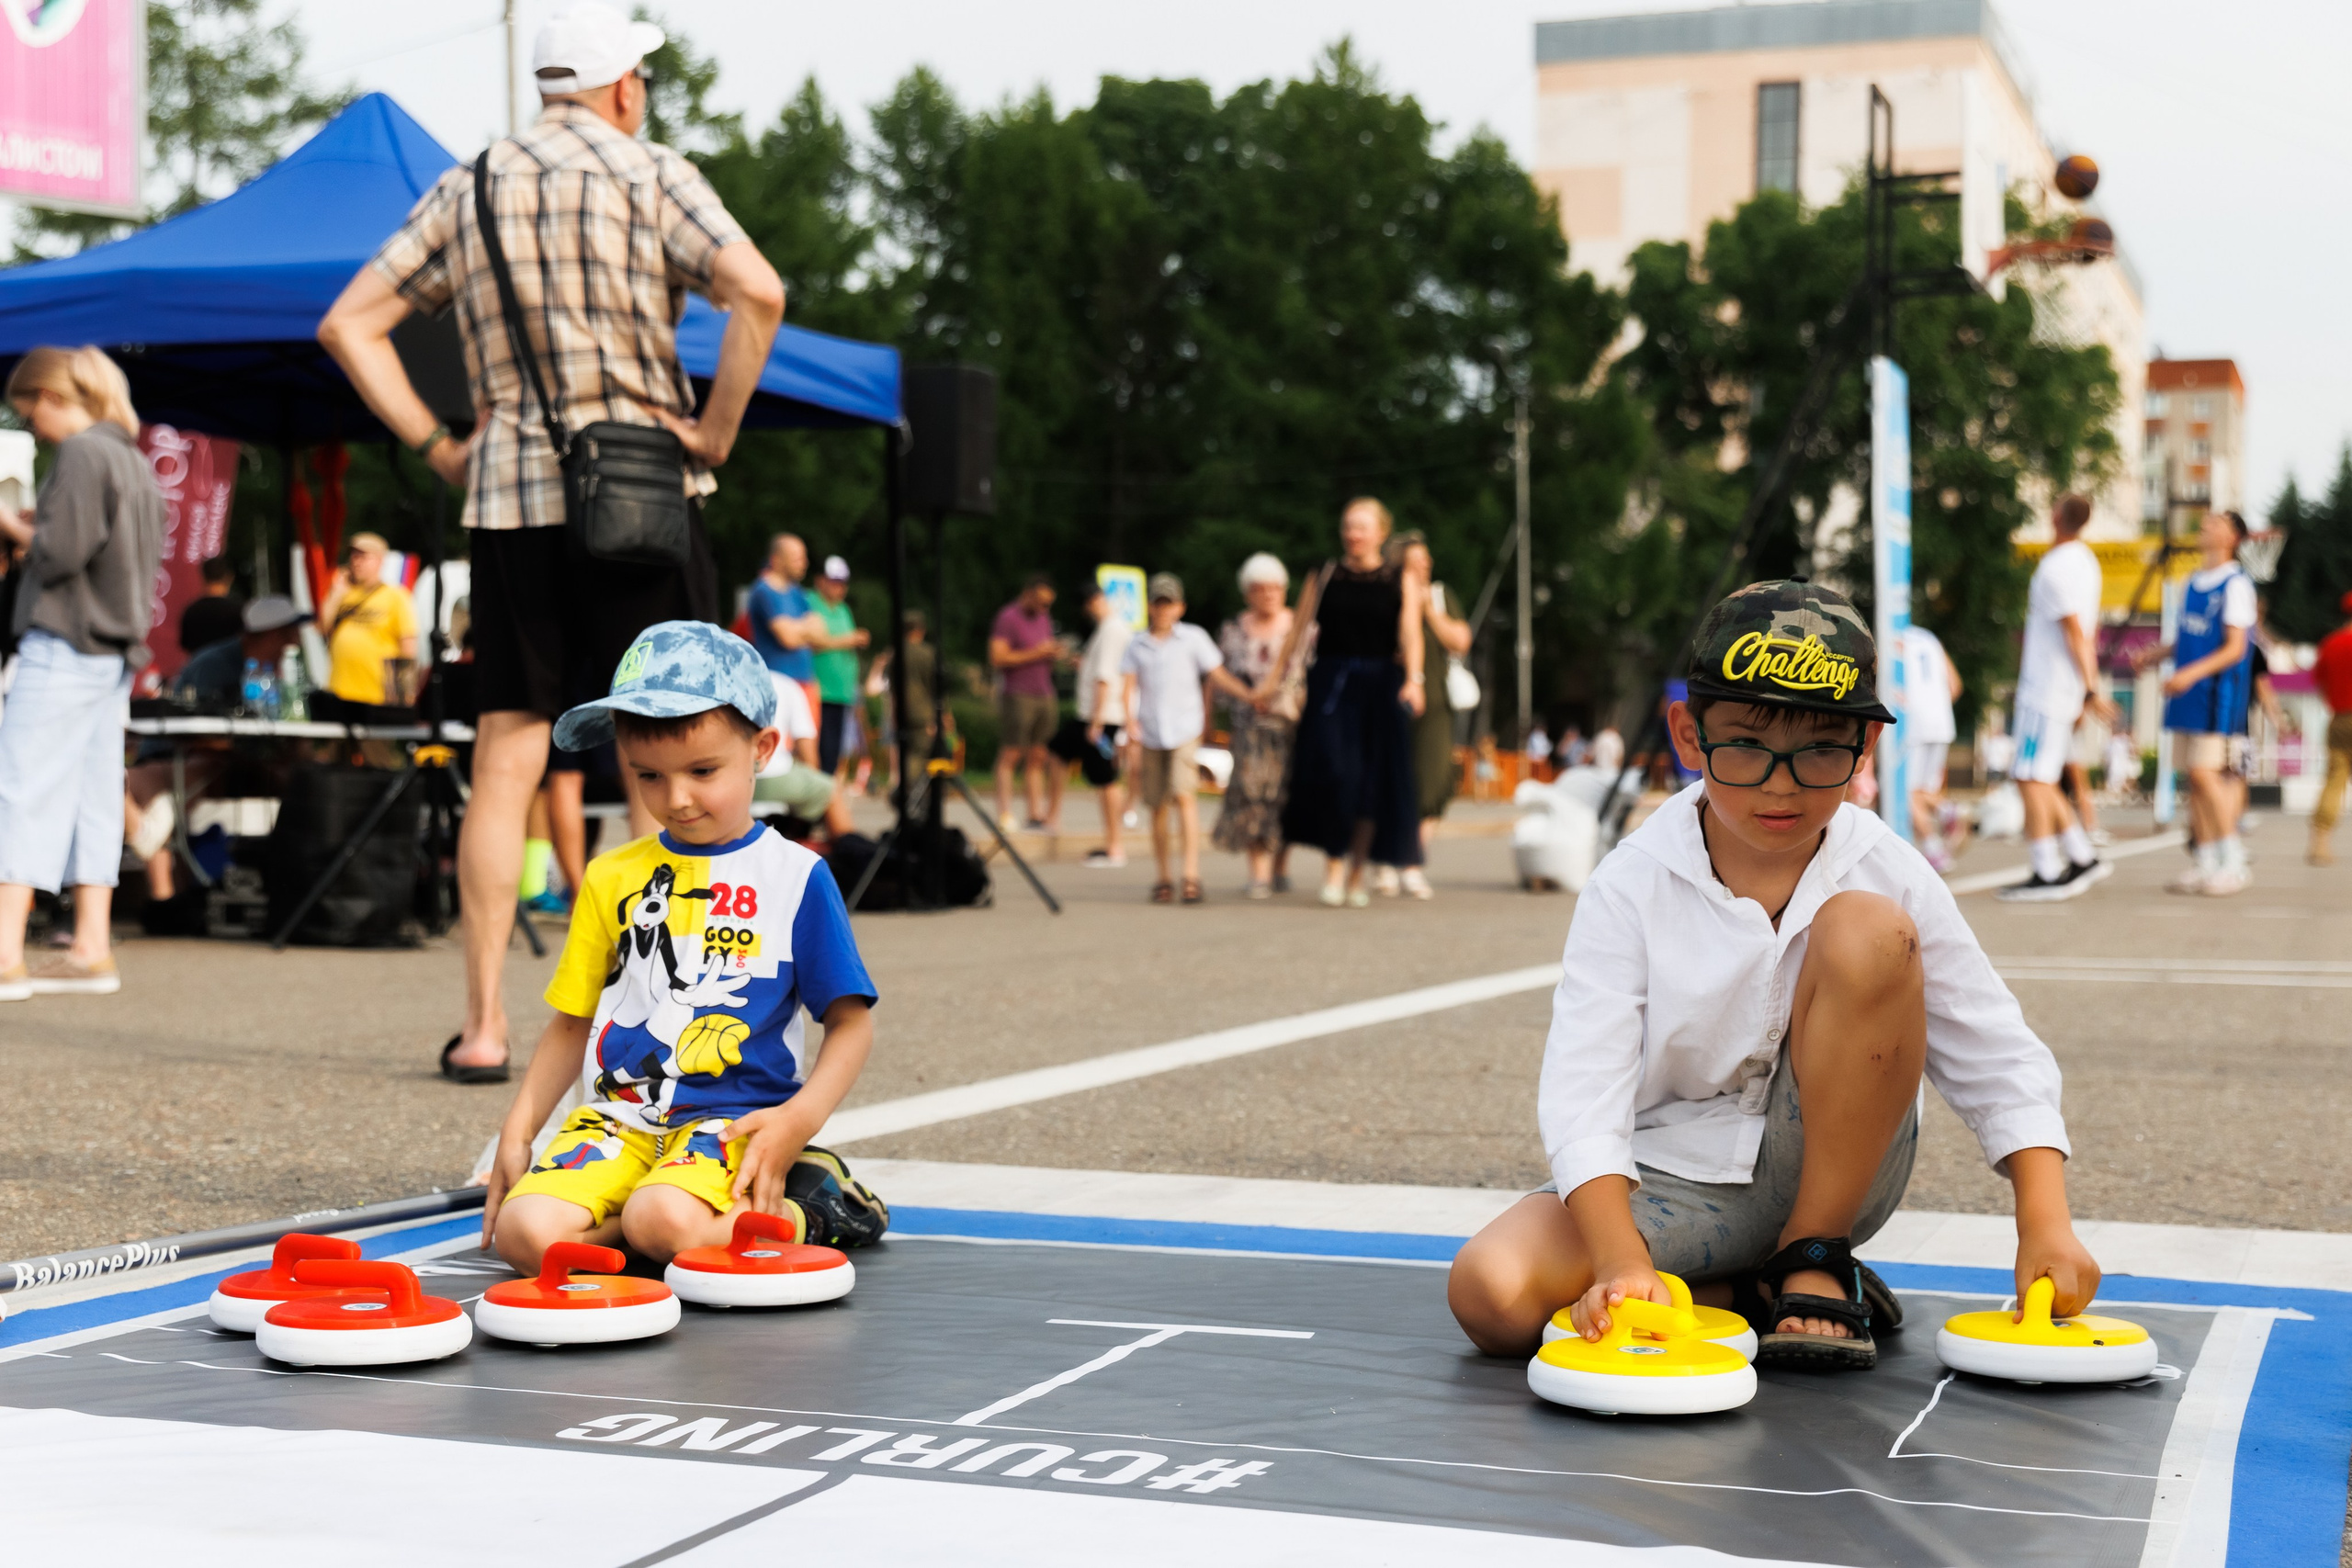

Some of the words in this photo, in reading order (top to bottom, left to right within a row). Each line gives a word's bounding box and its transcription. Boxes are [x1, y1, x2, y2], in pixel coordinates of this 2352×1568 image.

[1722, 631, 1860, 701] Challenge
[709, 882, 758, 919] 28
[705, 925, 754, 946] GOO
[8, 1241, 181, 1292] BalancePlus
[554, 1412, 1275, 1495] #CURLING
